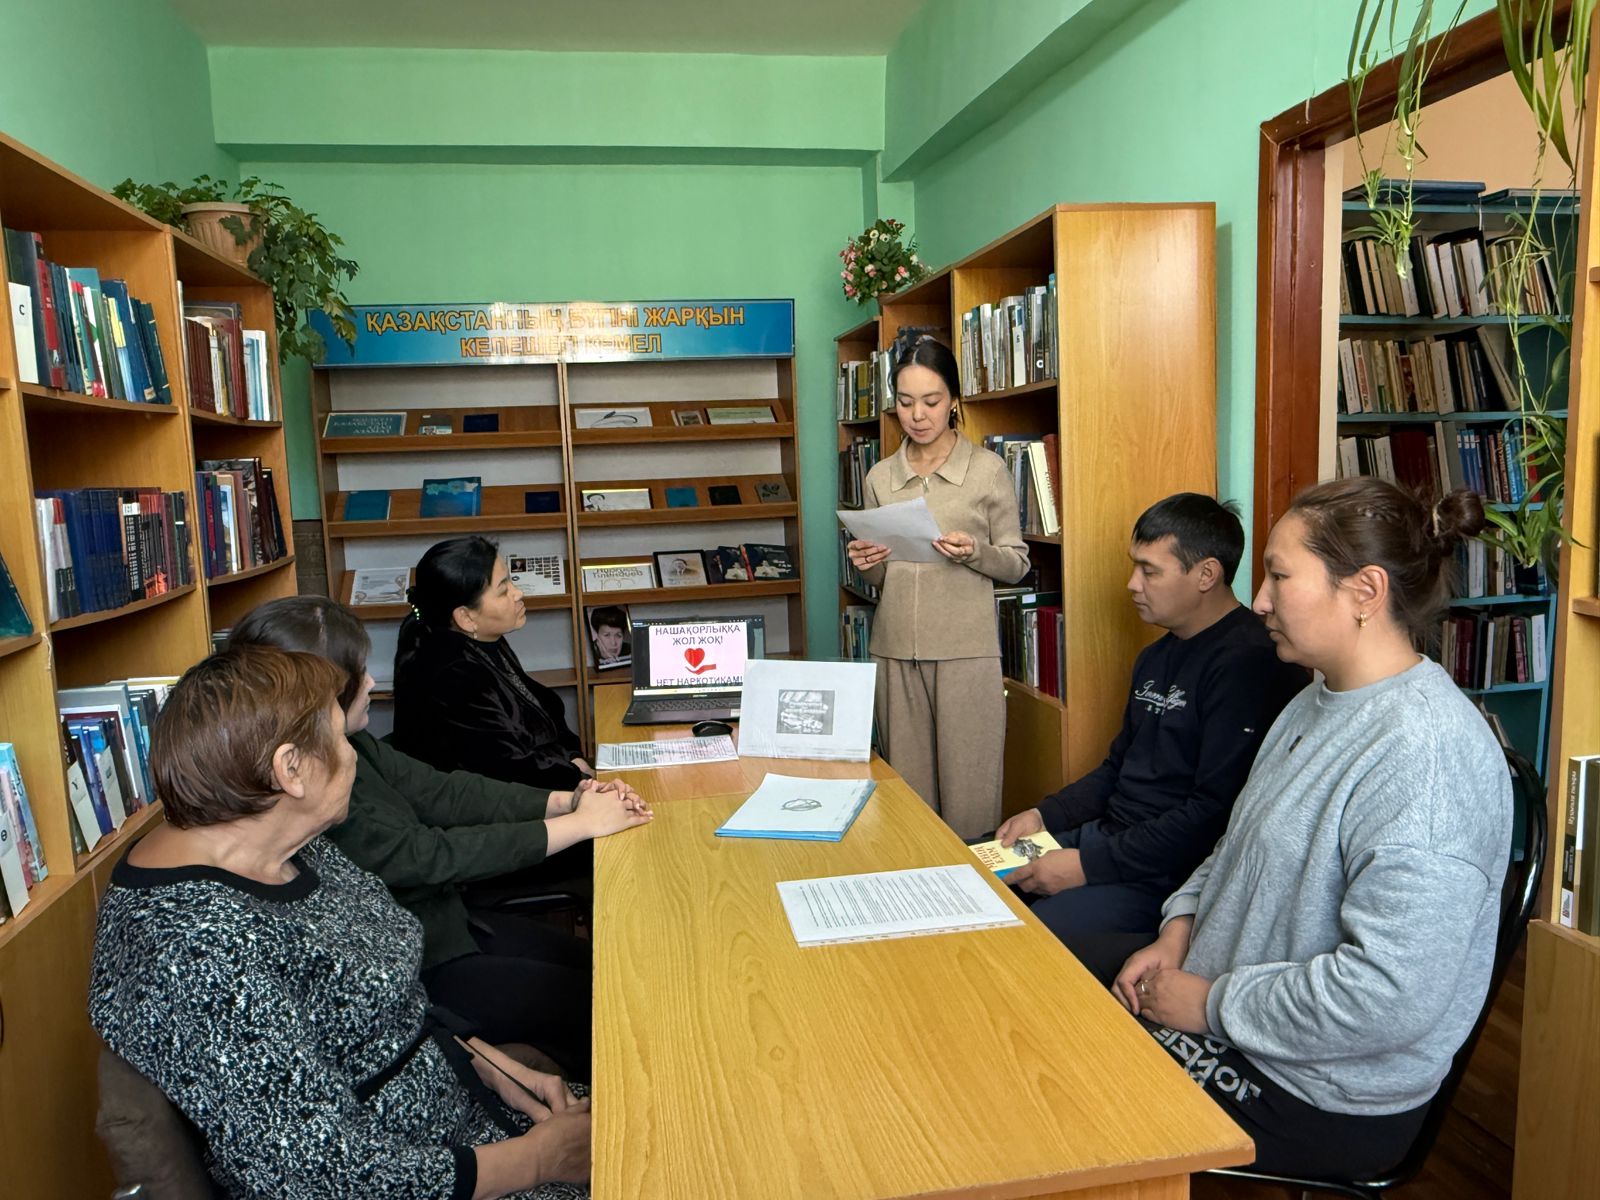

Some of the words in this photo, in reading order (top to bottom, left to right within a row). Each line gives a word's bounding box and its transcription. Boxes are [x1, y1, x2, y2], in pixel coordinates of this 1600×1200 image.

[366, 308, 562, 335] ҚАЗАҚСТАННЫҢ
[644, 306, 745, 329] ЖАРҚЫН
[655, 624, 741, 636] НАШАҚОРЛЫҚҚА
[672, 637, 696, 646] ЖОЛ
[698, 635, 724, 645] ЖОҚ!
